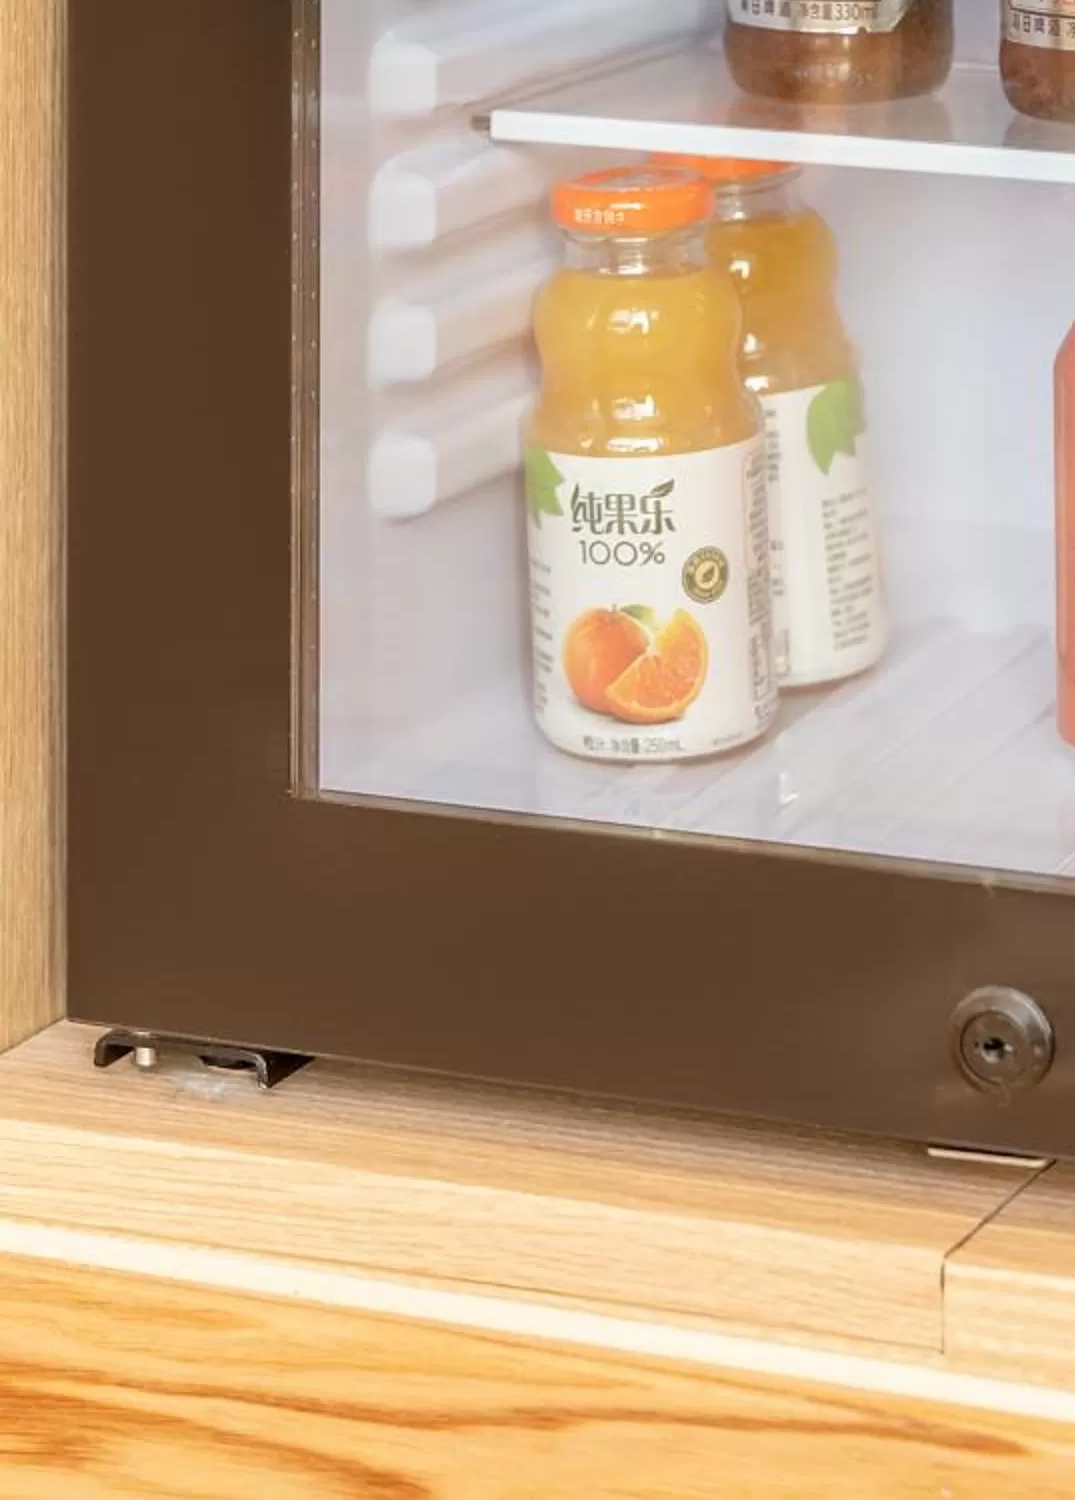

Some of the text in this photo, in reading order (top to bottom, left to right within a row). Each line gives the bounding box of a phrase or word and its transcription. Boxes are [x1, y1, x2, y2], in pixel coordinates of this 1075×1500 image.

[569, 478, 677, 536] 纯果乐
[578, 539, 666, 567] 100%
